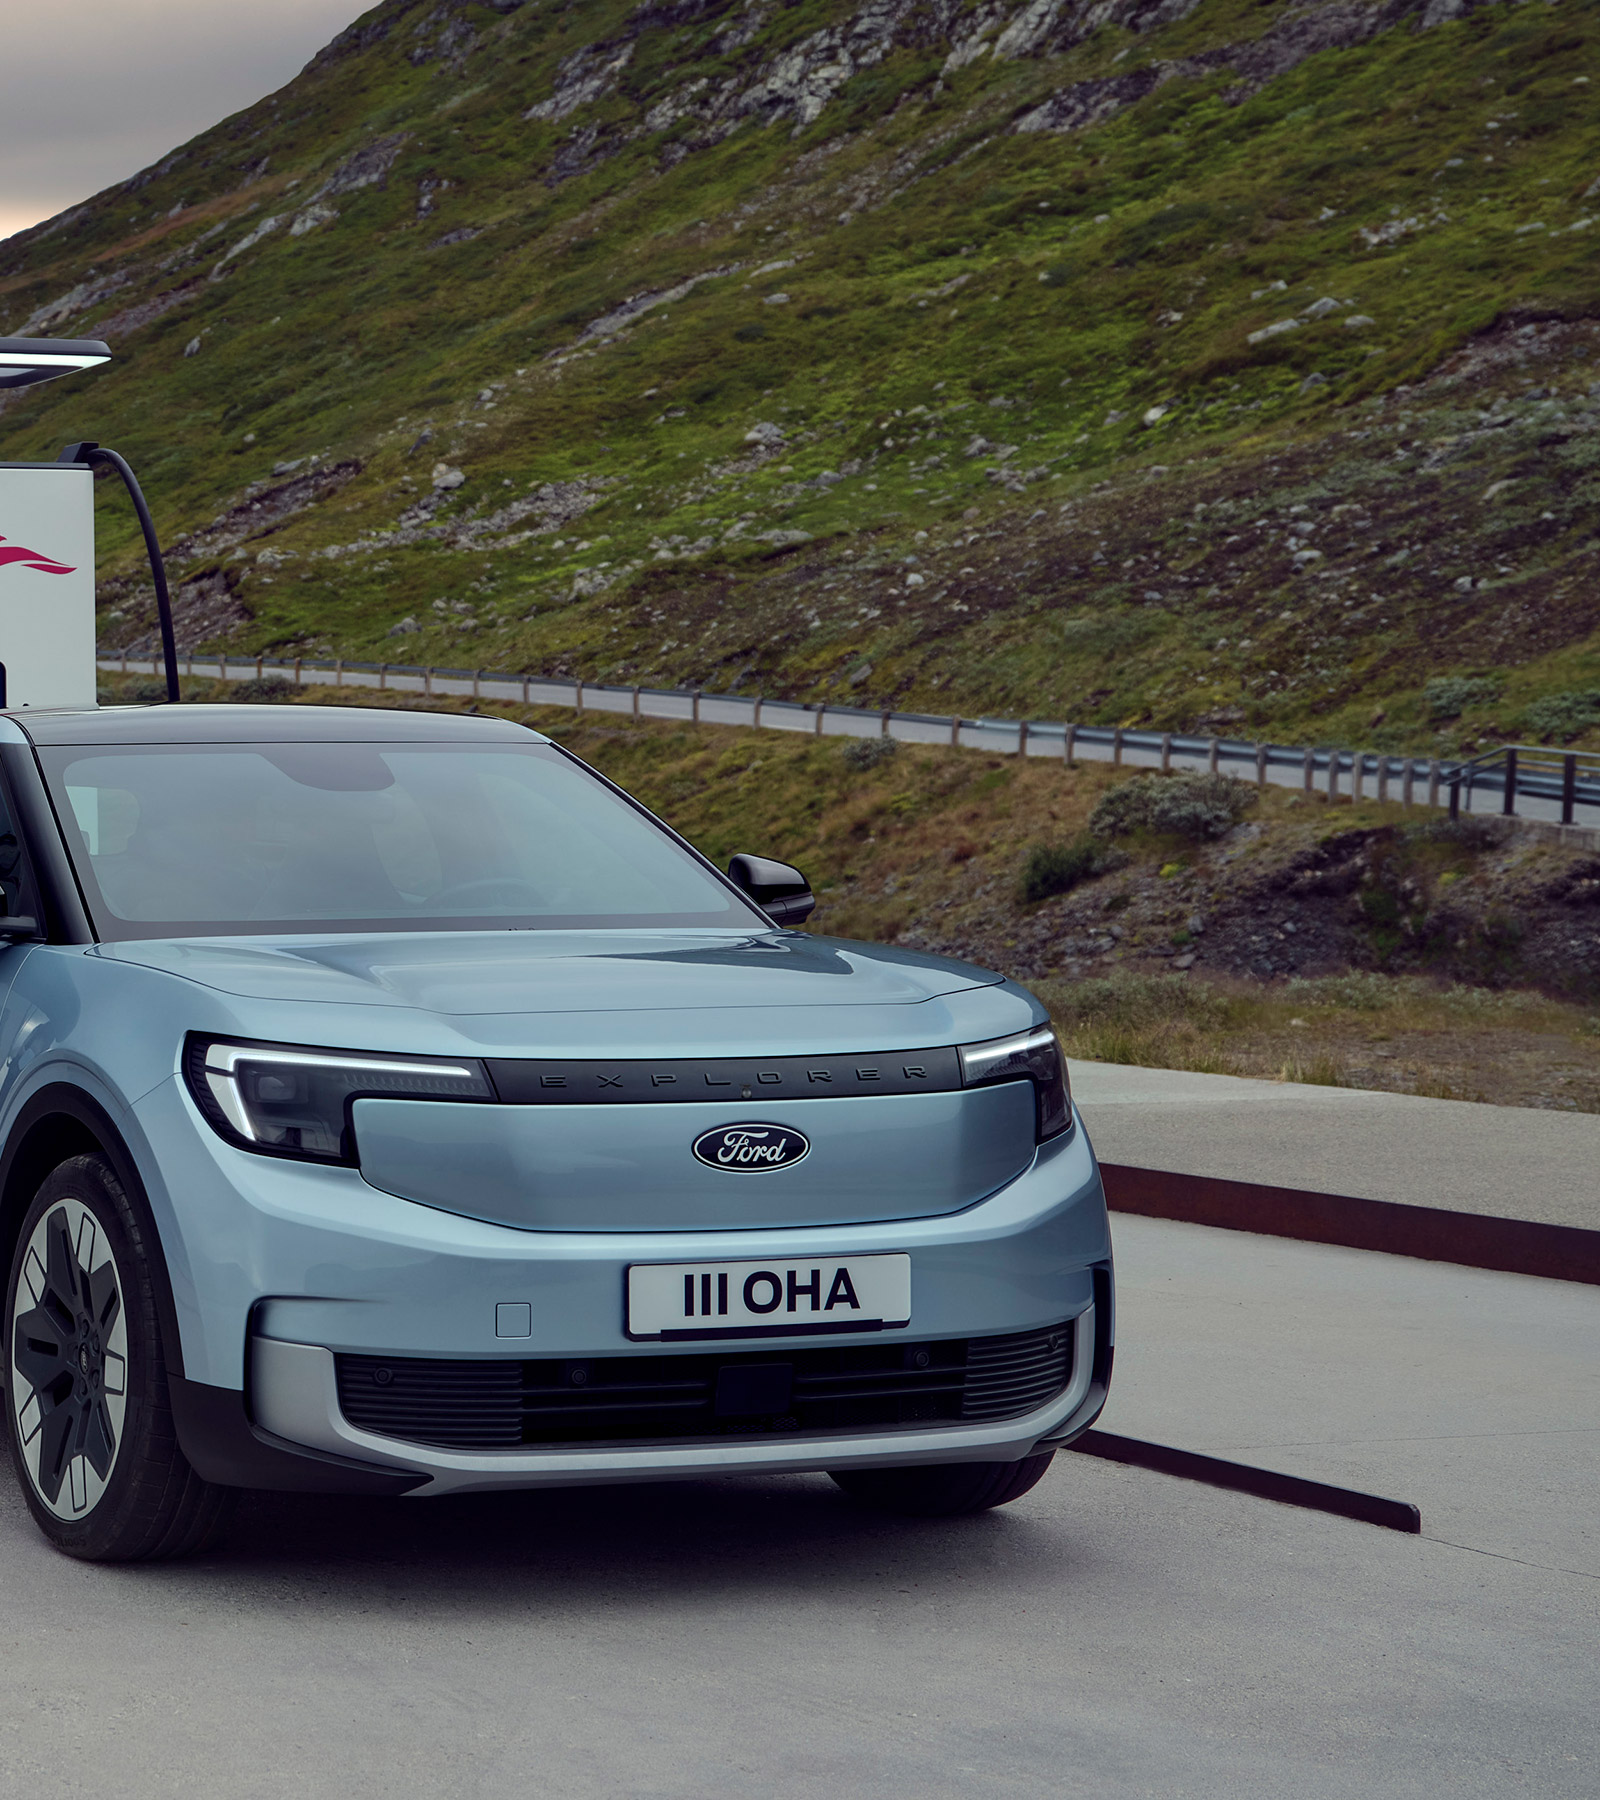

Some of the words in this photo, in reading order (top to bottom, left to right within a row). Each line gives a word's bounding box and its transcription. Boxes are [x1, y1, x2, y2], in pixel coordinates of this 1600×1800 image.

[539, 1065, 928, 1088] EXPLORER
[717, 1130, 788, 1163] Ford
[743, 1267, 861, 1315] OHA
